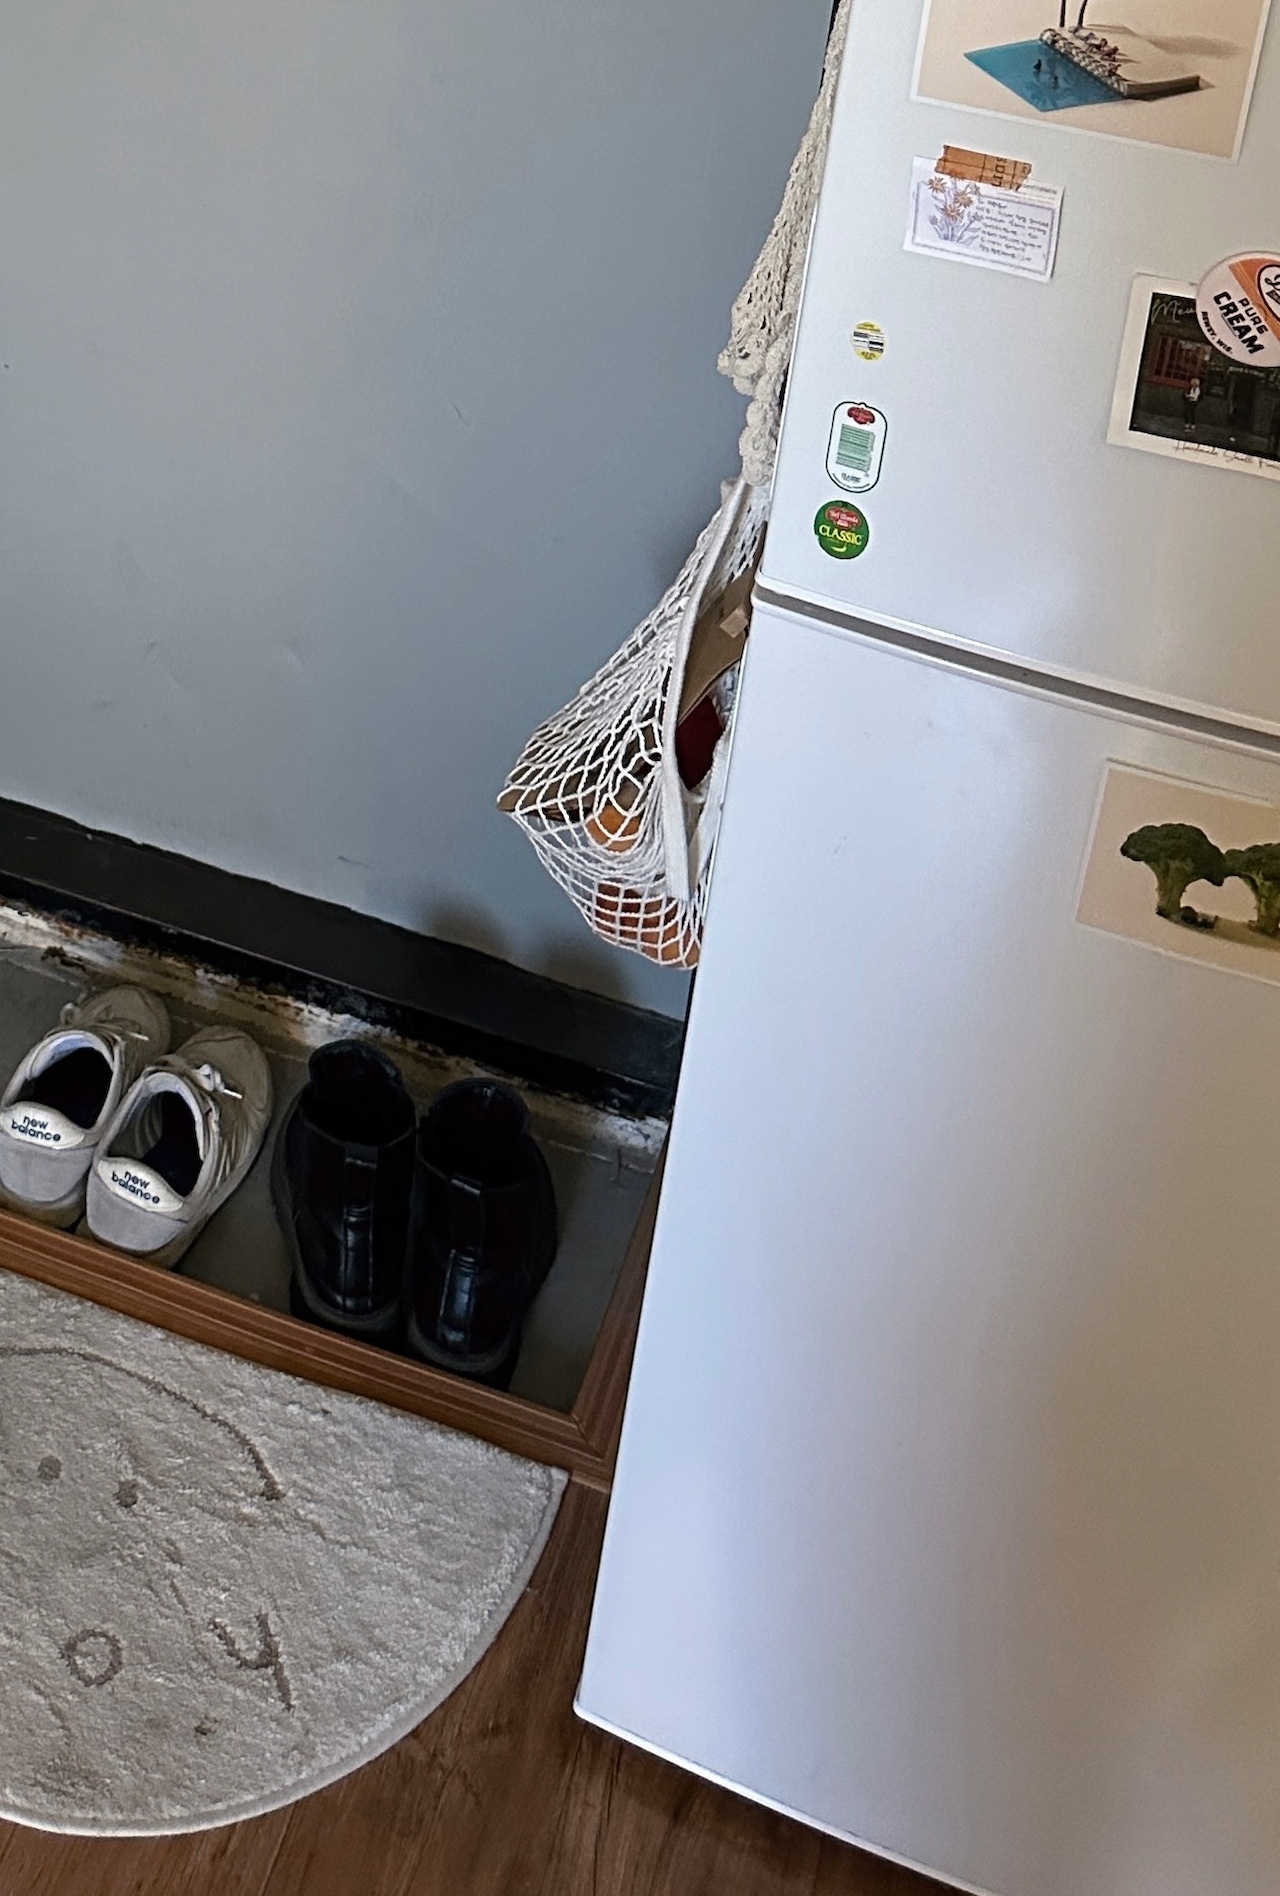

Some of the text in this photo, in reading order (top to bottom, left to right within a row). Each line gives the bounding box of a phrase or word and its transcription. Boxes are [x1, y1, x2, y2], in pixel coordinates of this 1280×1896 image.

[1213, 291, 1266, 355] CREAM
[1238, 297, 1270, 335] PURE
[819, 524, 863, 546] CLASSIC
[11, 1119, 62, 1142] balance
[23, 1115, 49, 1131] new
[111, 1171, 161, 1205] balance
[124, 1171, 151, 1190] new
